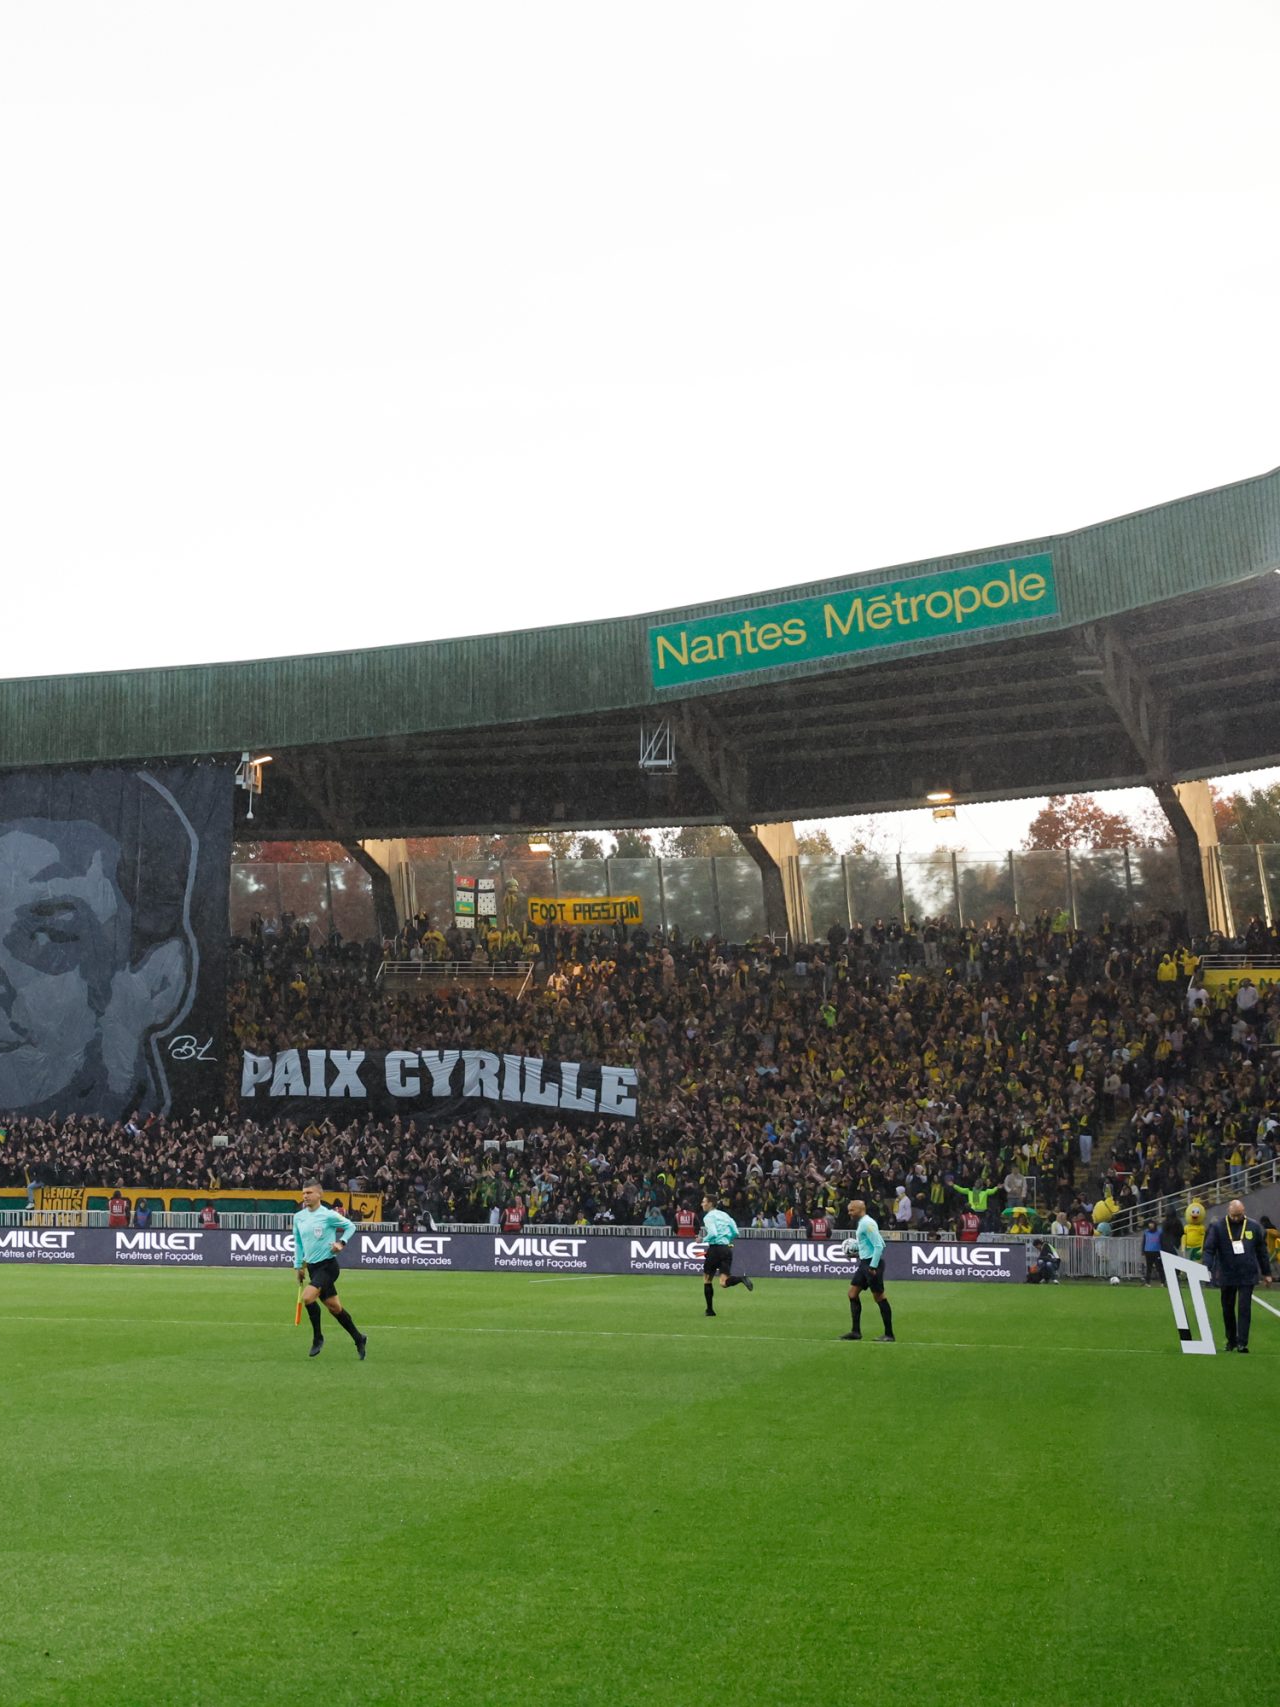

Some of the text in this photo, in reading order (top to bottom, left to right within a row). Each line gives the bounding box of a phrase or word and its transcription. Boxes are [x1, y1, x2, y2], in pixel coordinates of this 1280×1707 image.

[656, 618, 806, 669] Nantes
[530, 901, 639, 921] FOOT PASSION
[240, 1048, 639, 1117] PAIX CYRILLE
[44, 1187, 84, 1198] RENDEZ
[43, 1199, 81, 1211] NOUS
[116, 1232, 203, 1250] MILLET
[231, 1234, 296, 1251] MILLE
[361, 1236, 451, 1254] MILLET
[494, 1238, 586, 1257] MILLET
[27, 1250, 35, 1258] et
[38, 1250, 75, 1260] Façades
[116, 1251, 203, 1262] Fenêtres et Façades
[631, 1241, 709, 1259] MILLE
[770, 1243, 856, 1262] MILLE
[912, 1246, 1010, 1266] MILLET
[231, 1253, 267, 1262] Fenêtres
[269, 1254, 278, 1262] et
[361, 1255, 451, 1266] Fenêtres et Façades
[494, 1257, 587, 1269] Fenêtres et Façades
[631, 1261, 670, 1270] Fenêtres
[672, 1262, 681, 1270] et
[770, 1263, 858, 1275] Fenêtres et Façad
[912, 1266, 1010, 1278] Fenêtres et Façades
